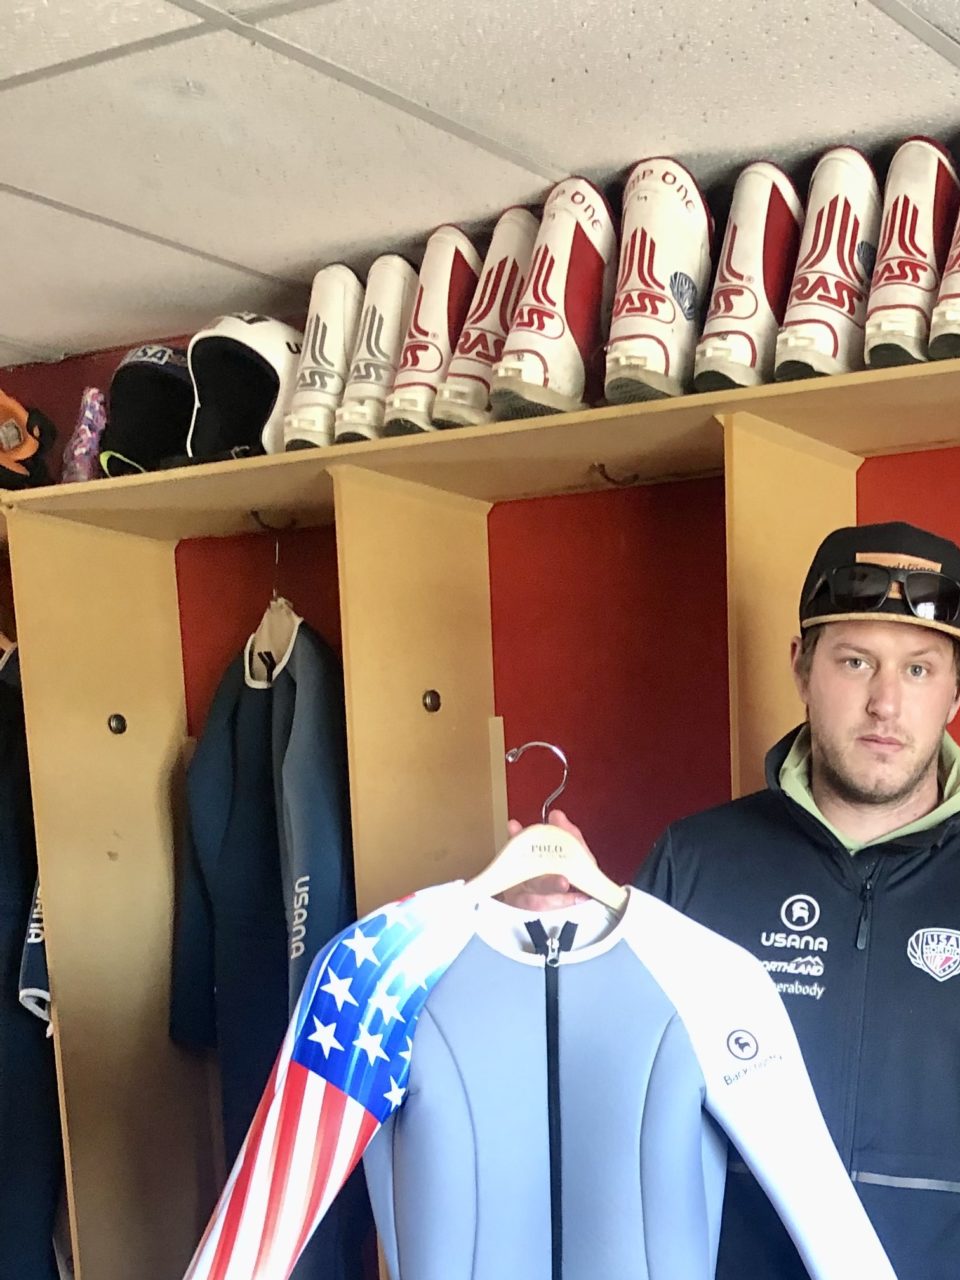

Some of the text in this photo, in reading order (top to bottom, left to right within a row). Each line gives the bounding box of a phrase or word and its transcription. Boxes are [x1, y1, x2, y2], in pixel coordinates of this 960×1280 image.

[761, 932, 828, 952] USANA
[761, 960, 825, 977] ORTHLAND
[776, 981, 826, 1000] erabody
